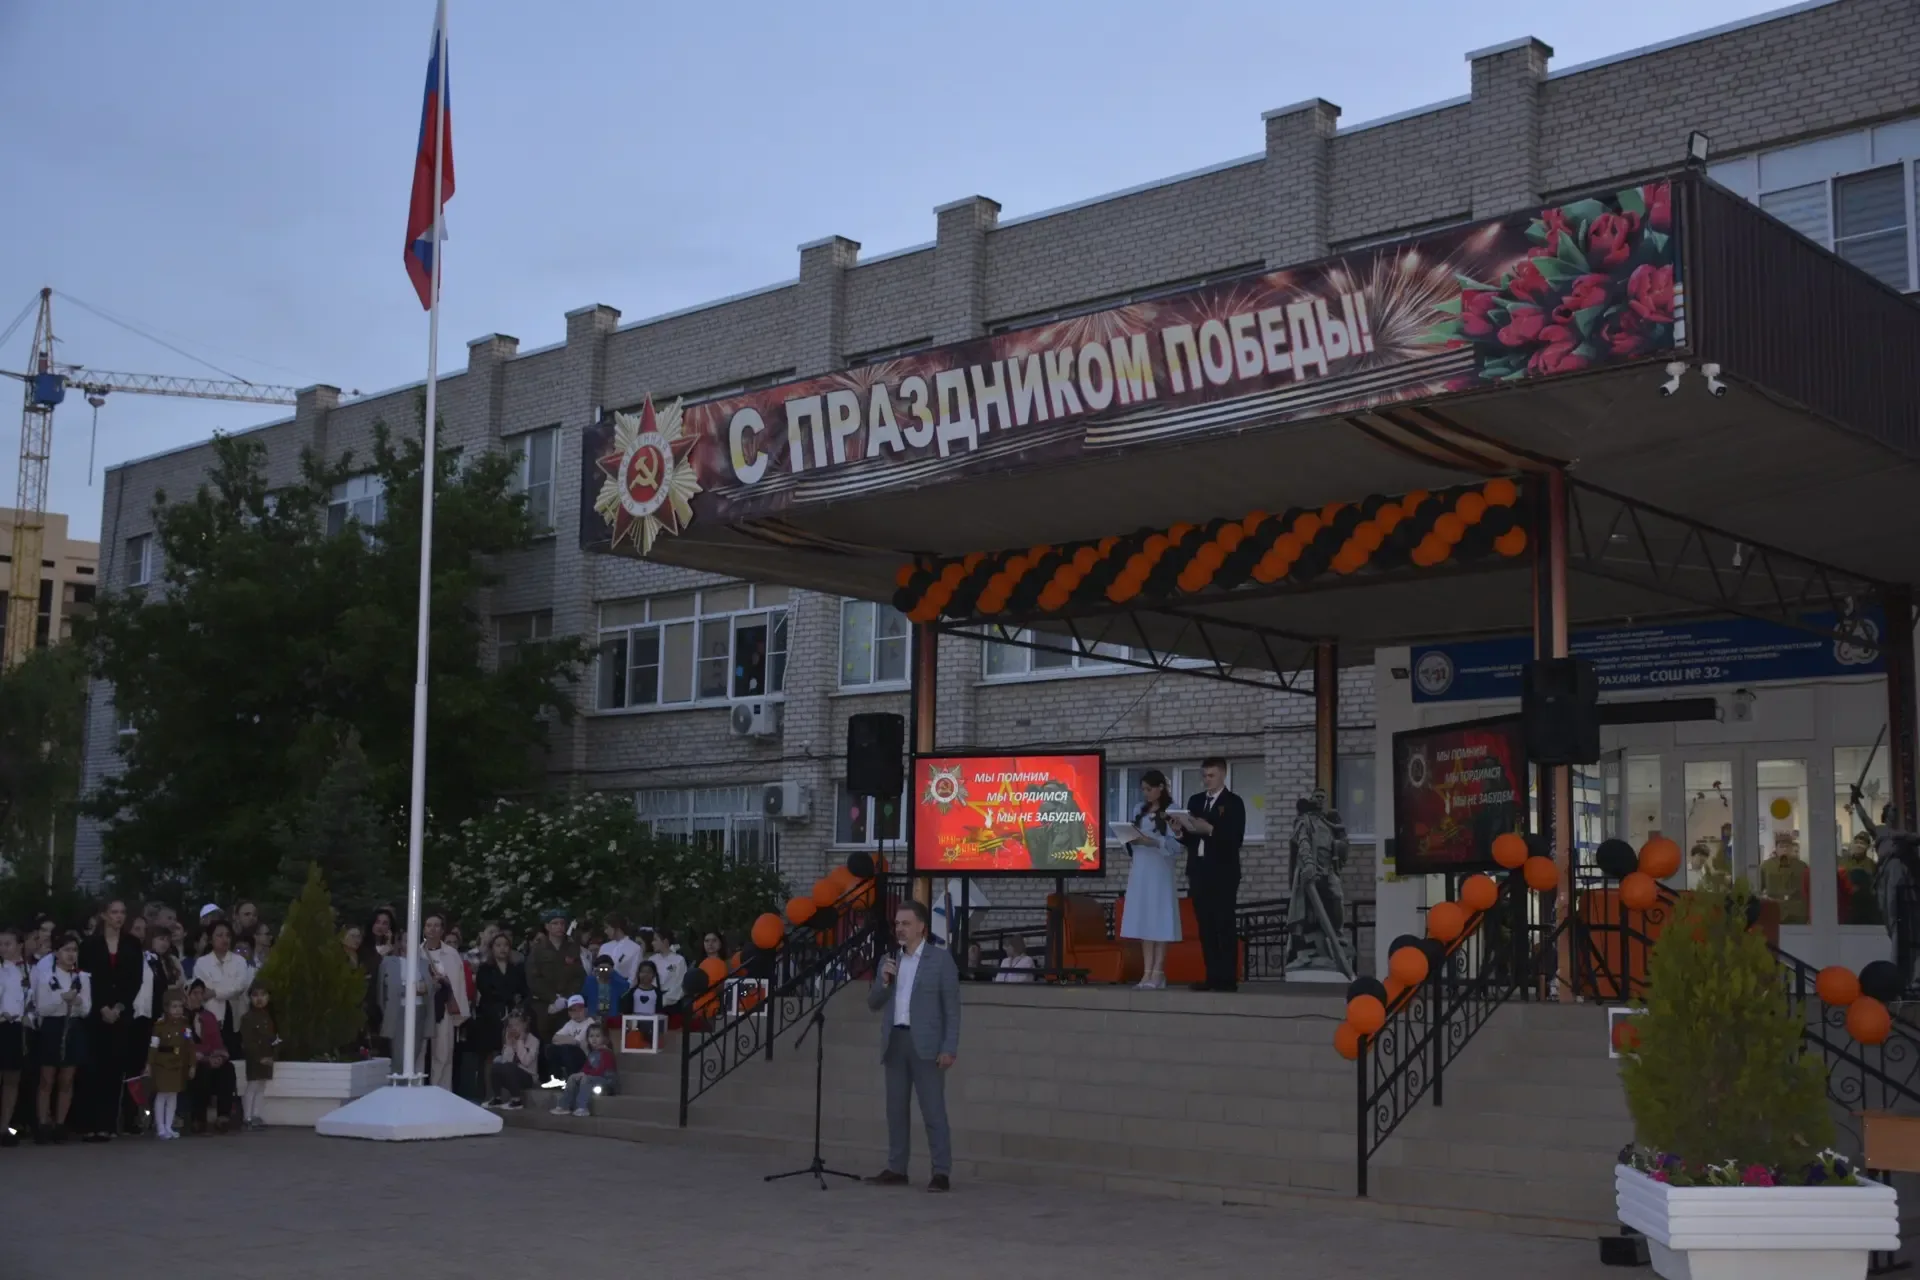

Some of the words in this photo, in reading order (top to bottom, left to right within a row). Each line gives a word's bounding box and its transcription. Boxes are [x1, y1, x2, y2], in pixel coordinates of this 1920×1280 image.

[728, 406, 769, 485] С
[785, 333, 1157, 474] ПРАЗДНИКОМ
[1162, 291, 1375, 396] ПОБЕДЫ!
[1685, 667, 1701, 680] №
[1437, 751, 1450, 761] МЫ
[1451, 745, 1487, 760] ПОМНИМ
[974, 772, 995, 783] МЫ
[997, 772, 1049, 783] ПОМНИМ
[1445, 772, 1459, 783] МЫ
[1460, 766, 1500, 781] ГОРДИМСЯ
[986, 791, 1007, 803] МЫ
[1009, 791, 1069, 803] ГОРДИМСЯ
[1453, 795, 1467, 808] МЫ
[1467, 794, 1478, 805] НЕ
[1479, 790, 1515, 804] ЗАБУДЕМ
[997, 812, 1017, 823] МЫ
[1020, 812, 1033, 823] НЕ
[1035, 811, 1086, 823] ЗАБУДЕМ
